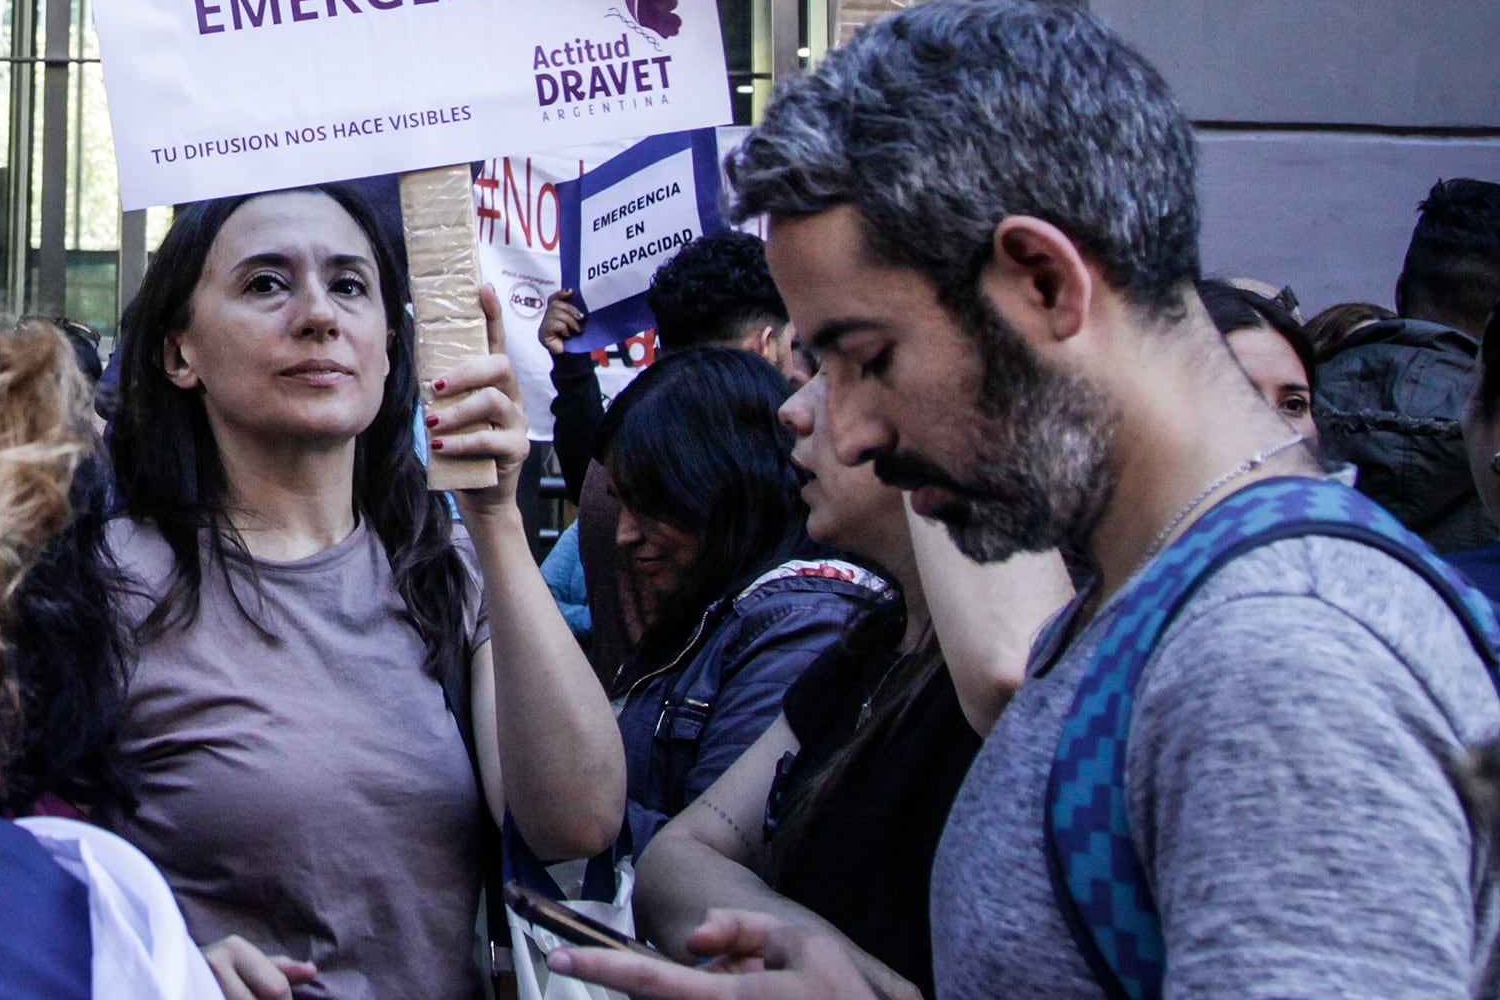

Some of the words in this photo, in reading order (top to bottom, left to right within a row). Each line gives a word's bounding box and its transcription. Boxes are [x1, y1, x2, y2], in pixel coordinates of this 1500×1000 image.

[533, 33, 631, 70] Actitud
[535, 55, 674, 107] DRAVET
[541, 93, 671, 122] ARGENTINA
[150, 147, 180, 165] TU
[183, 132, 280, 161] DIFUSION
[285, 124, 328, 147] NOS
[332, 116, 386, 140] HACE
[388, 105, 473, 130] VISIBLES
[474, 156, 583, 252] #No
[592, 181, 682, 233] EMERGENCIA
[587, 227, 694, 282] DISCAPACIDAD
[624, 220, 646, 241] EN
